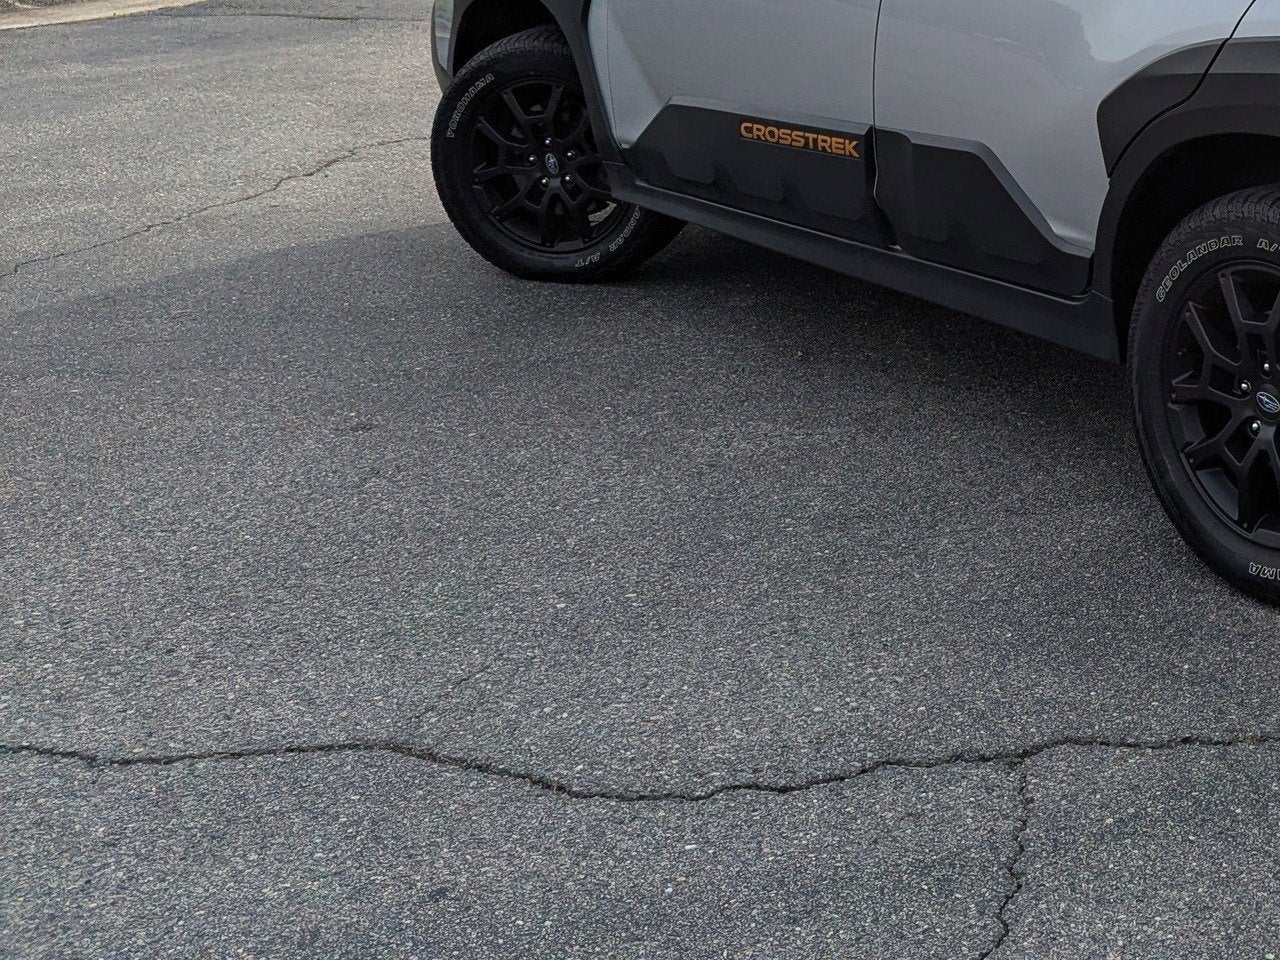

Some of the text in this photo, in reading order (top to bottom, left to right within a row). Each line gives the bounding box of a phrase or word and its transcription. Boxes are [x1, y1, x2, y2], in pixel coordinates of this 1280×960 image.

[446, 73, 495, 138] YOKOHAMA
[740, 122, 860, 158] CROSSTREK
[1156, 235, 1244, 303] GEOLANDAR
